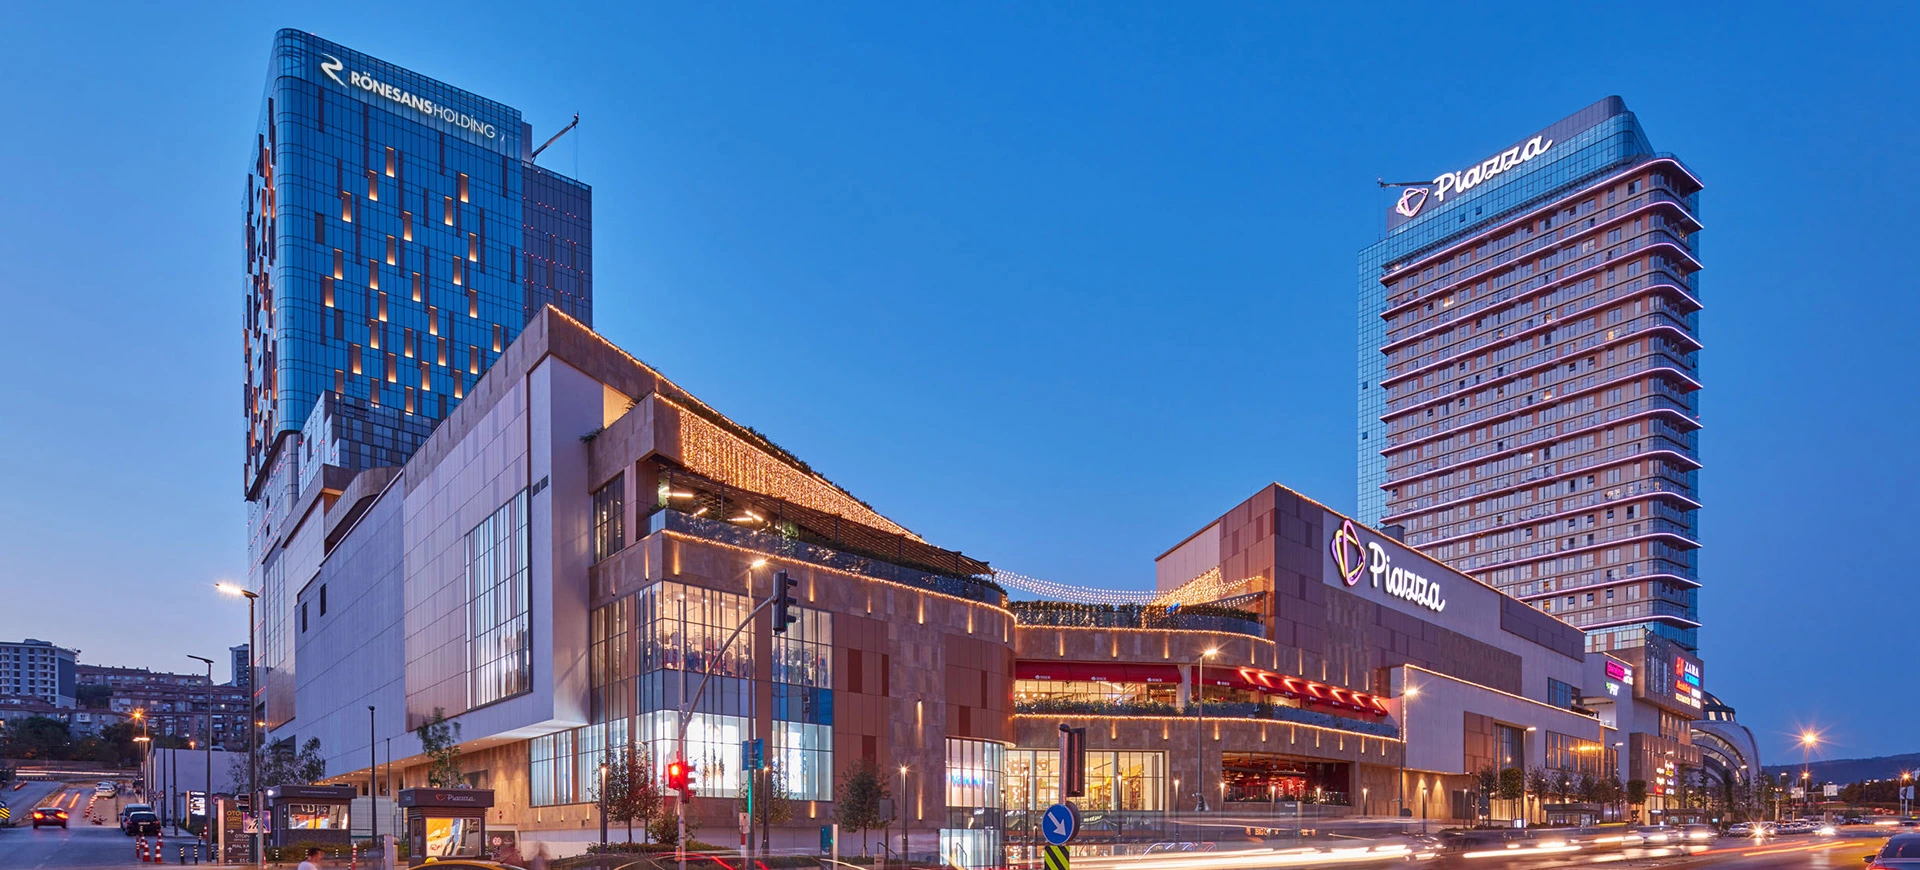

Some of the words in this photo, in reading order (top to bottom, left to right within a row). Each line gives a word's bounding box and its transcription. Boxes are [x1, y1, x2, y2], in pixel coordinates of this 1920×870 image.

[1433, 135, 1553, 202] Piazza
[1369, 542, 1445, 611] Piazza
[1684, 661, 1700, 678] ZARA
